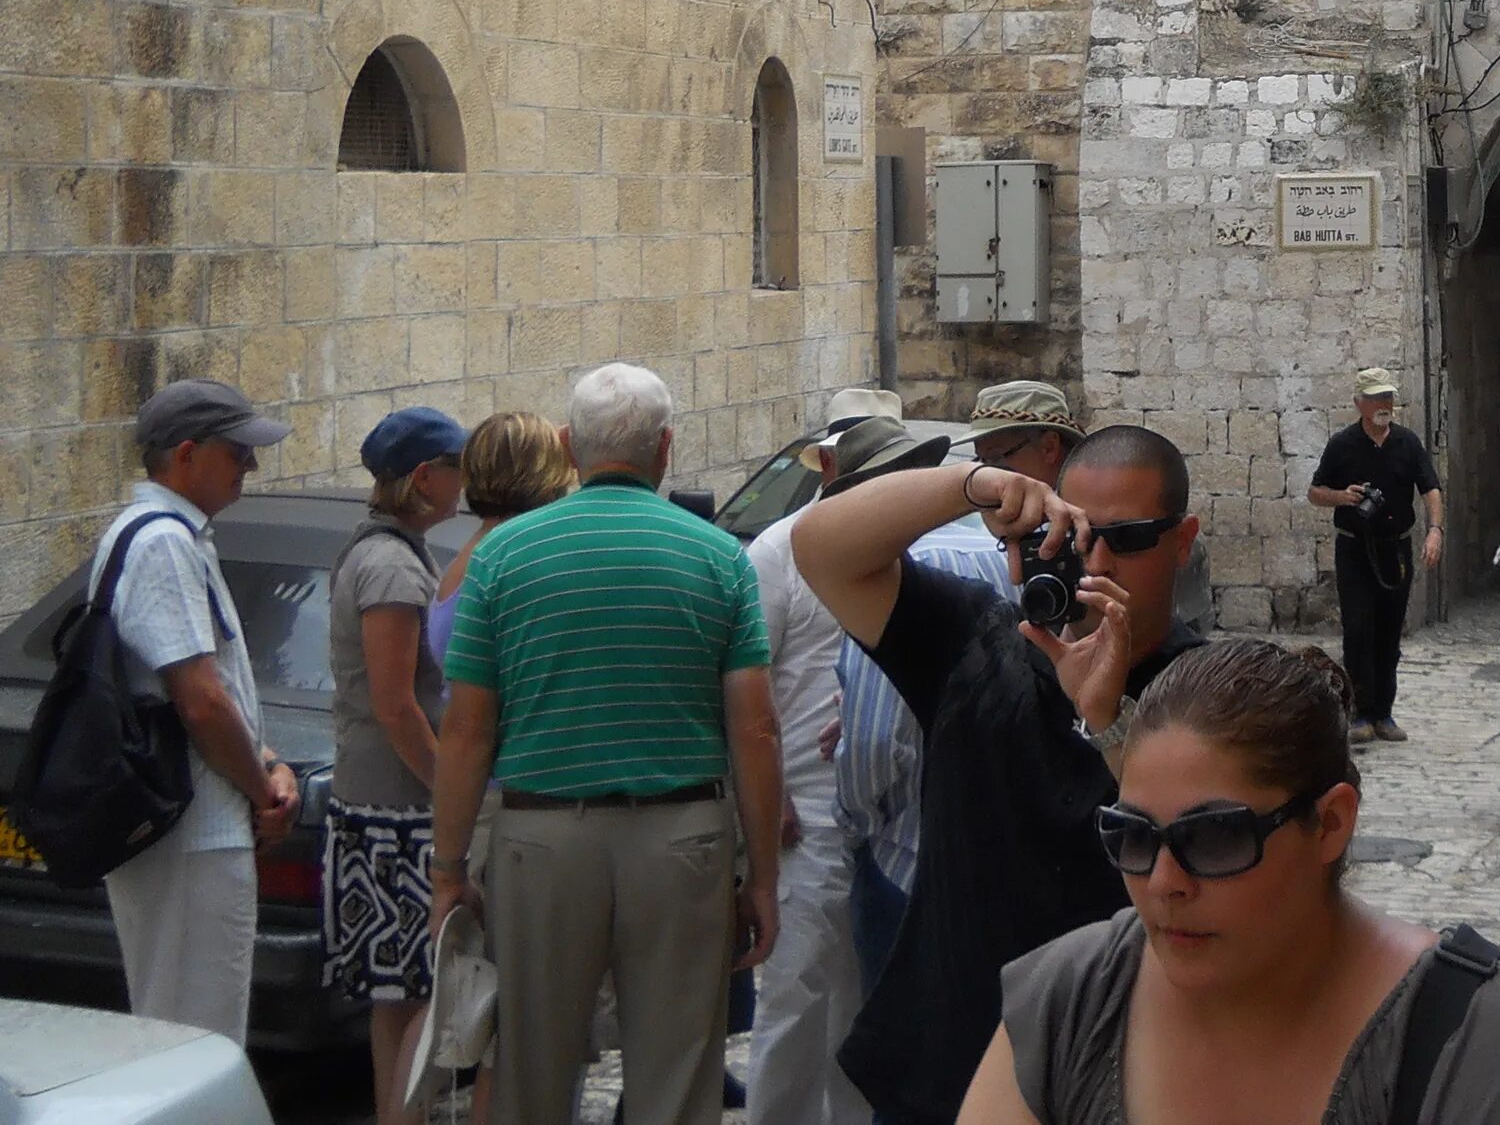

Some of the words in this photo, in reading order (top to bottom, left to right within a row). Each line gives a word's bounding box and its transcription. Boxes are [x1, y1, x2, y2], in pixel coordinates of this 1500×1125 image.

[1340, 185, 1363, 196] רחוב
[1296, 204, 1315, 217] حطة
[1317, 204, 1333, 219] باب
[1334, 204, 1357, 218] طريق
[1294, 230, 1311, 242] BAB
[1315, 229, 1342, 242] HUTTA
[1345, 233, 1359, 241] ST.
